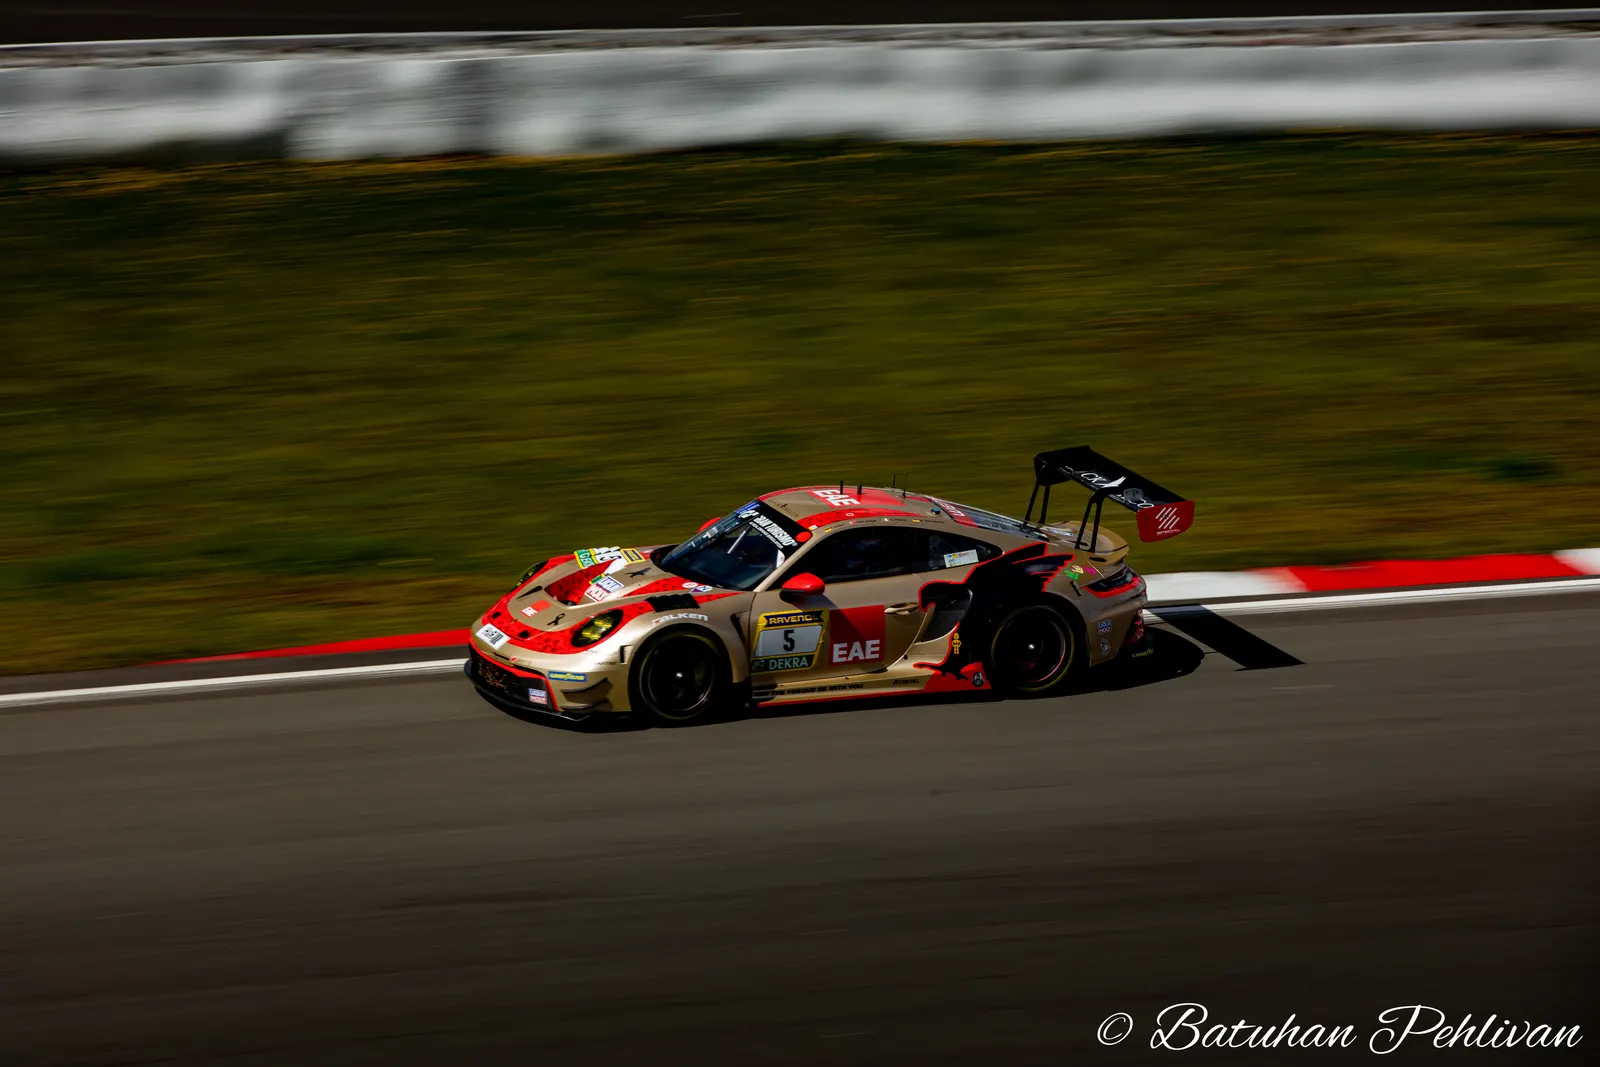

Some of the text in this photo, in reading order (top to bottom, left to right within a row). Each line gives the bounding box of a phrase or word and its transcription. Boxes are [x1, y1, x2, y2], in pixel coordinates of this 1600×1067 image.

[811, 489, 861, 507] EAE
[652, 612, 709, 625] FALKEN
[768, 613, 819, 625] RAVENOL
[783, 629, 796, 652] 5
[832, 639, 880, 663] EAE
[769, 657, 809, 670] DEKRA
